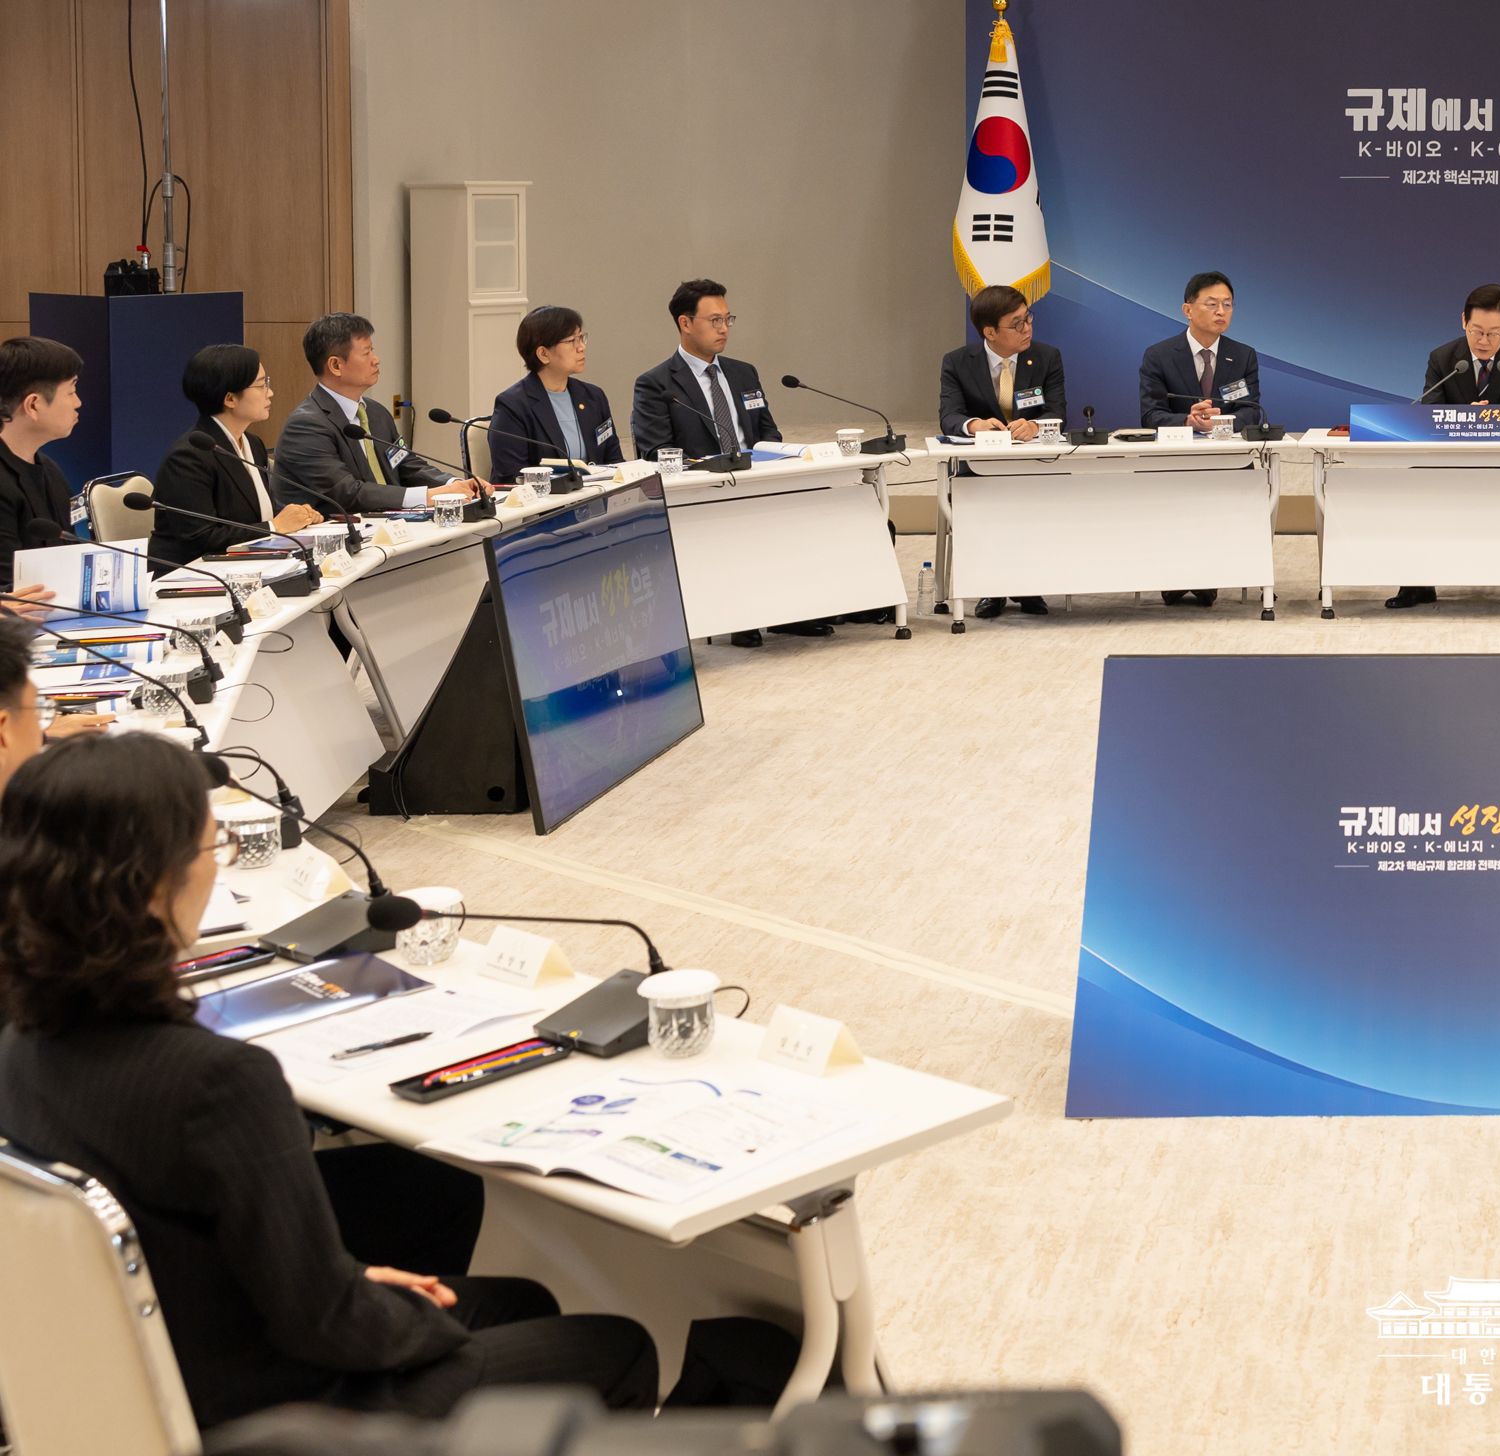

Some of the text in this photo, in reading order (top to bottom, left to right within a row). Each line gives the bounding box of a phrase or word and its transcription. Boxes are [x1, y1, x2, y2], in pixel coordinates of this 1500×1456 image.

[1345, 88, 1493, 132] 규제에서
[1358, 141, 1442, 159] K-바이오
[1402, 169, 1440, 186] 제2차
[1443, 169, 1499, 186] 핵심규제
[1432, 409, 1476, 422] 규제에서
[539, 592, 600, 648] 규제에서
[1339, 806, 1442, 837] 규제에서
[1347, 841, 1406, 854] K-바이오
[1425, 840, 1483, 853] K-에너지
[1378, 860, 1405, 872] 제2차
